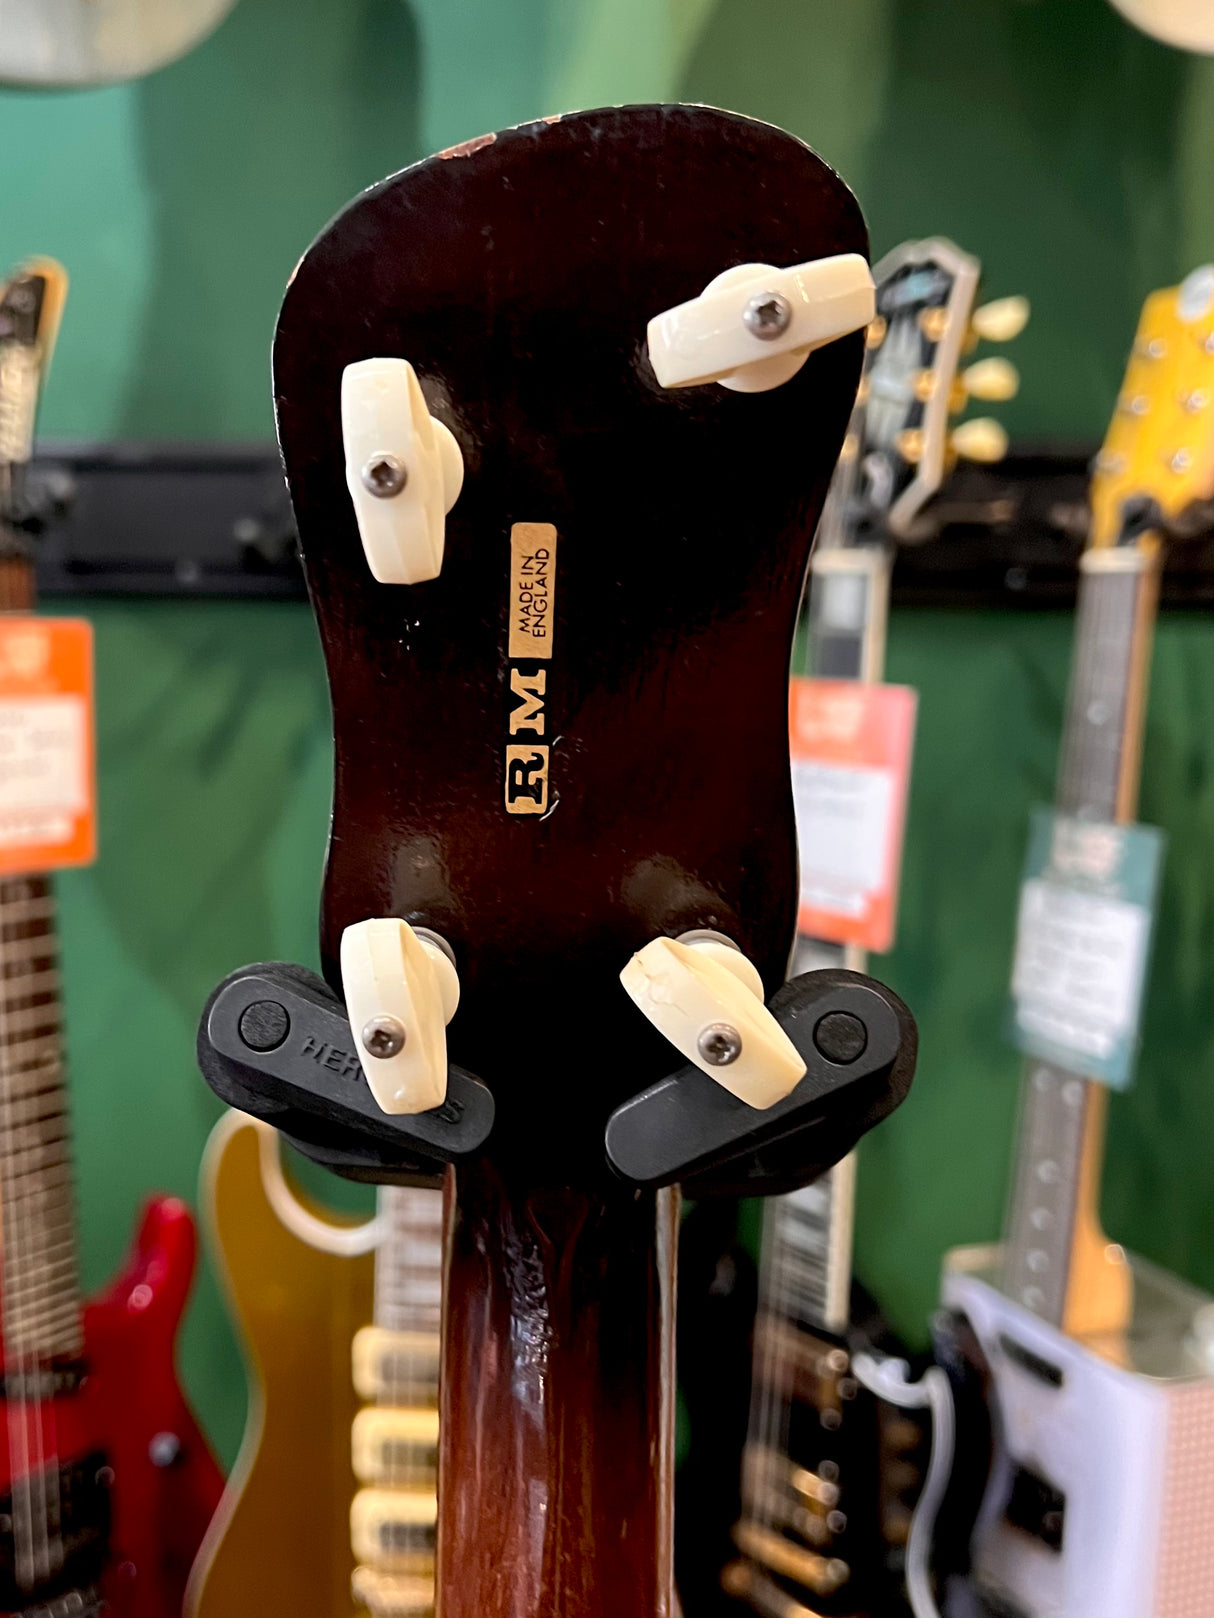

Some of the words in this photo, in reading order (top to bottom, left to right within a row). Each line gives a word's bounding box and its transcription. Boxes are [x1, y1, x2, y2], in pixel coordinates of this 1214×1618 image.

[520, 555, 535, 576] IN
[518, 581, 534, 633] MADE
[532, 548, 550, 638] ENGLAND
